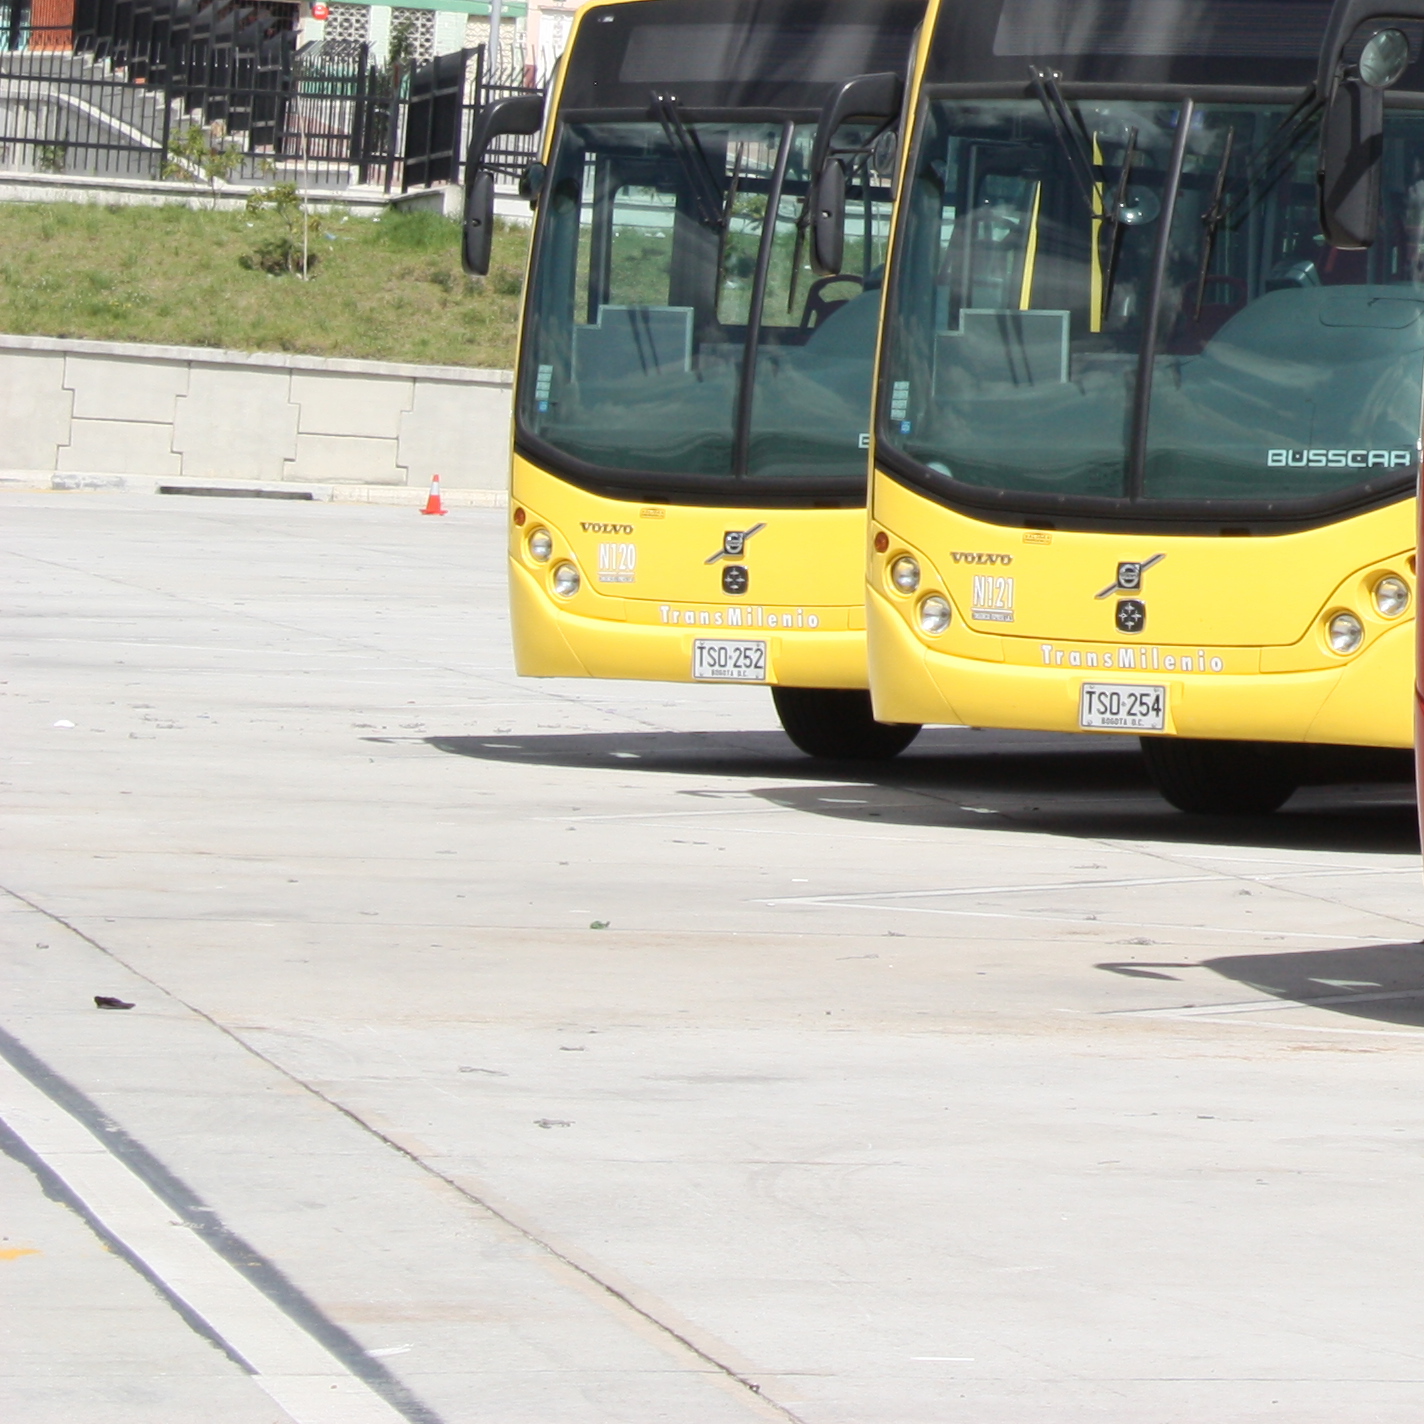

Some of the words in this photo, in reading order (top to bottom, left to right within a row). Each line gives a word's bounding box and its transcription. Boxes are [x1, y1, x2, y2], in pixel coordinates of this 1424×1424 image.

[1267, 449, 1411, 468] BUSSCAR
[580, 522, 634, 535] VOLVO
[599, 543, 636, 571] N120
[950, 551, 1013, 566] VOLVO
[973, 575, 1014, 609] N121
[660, 605, 820, 628] TransMilenio
[1041, 644, 1224, 672] TransMilenio
[1101, 717, 1128, 726] BOGOTA
